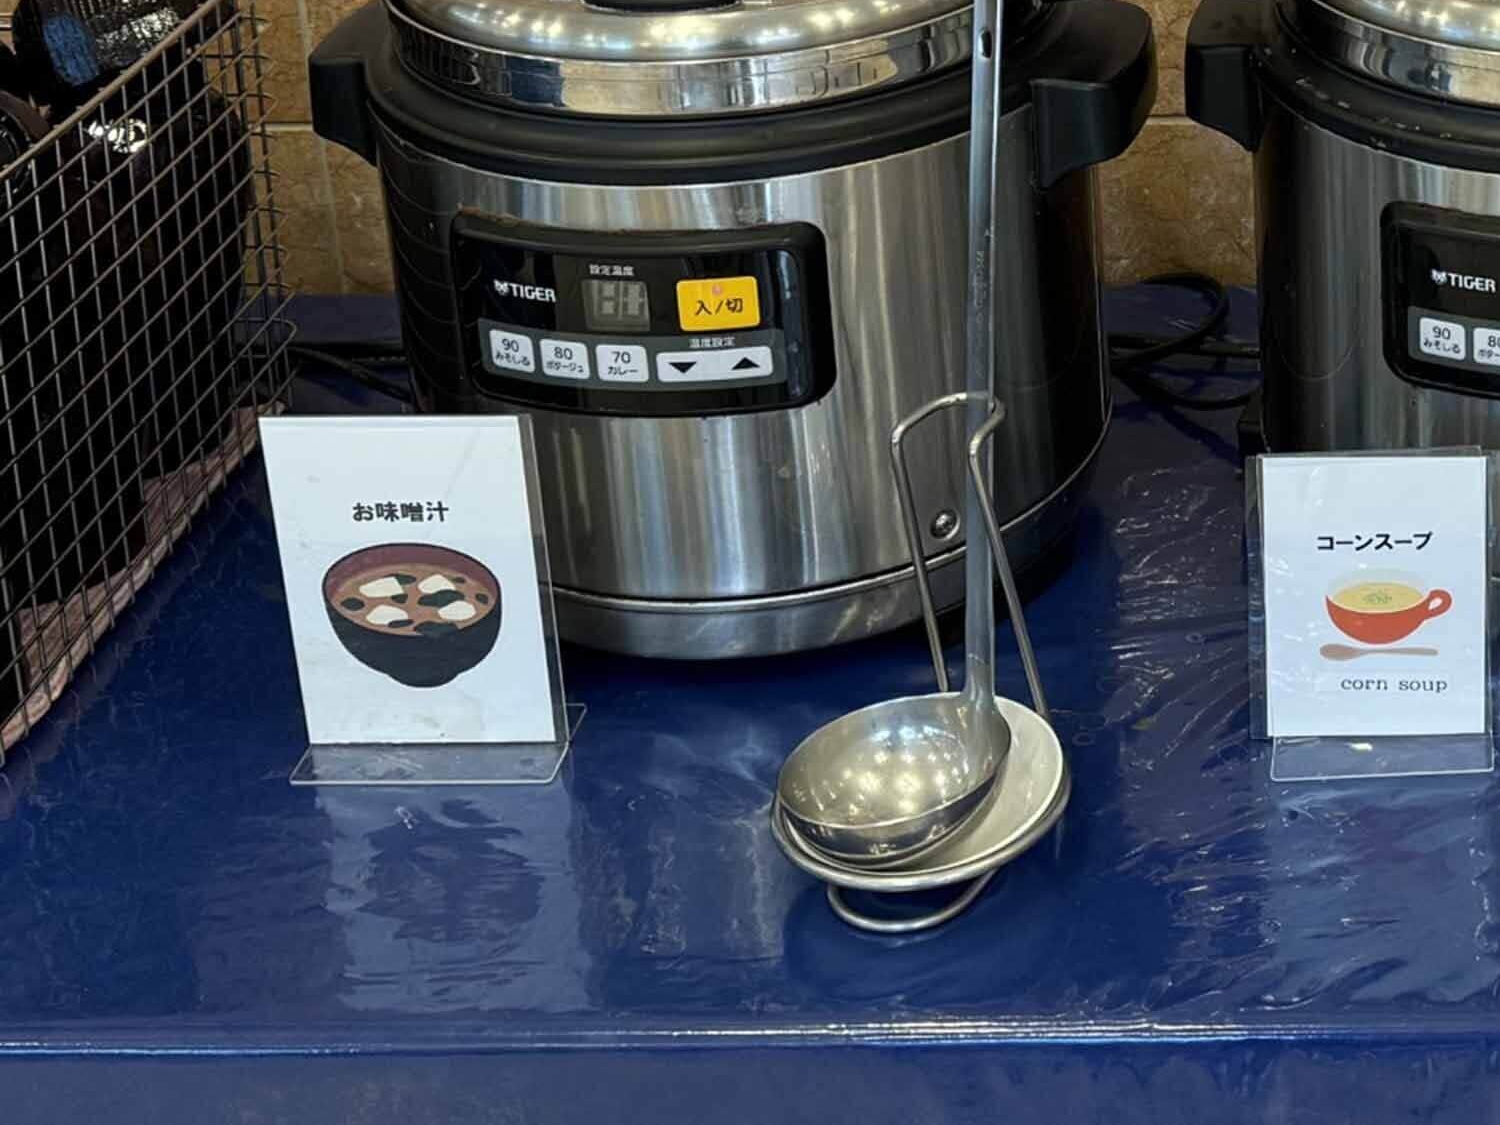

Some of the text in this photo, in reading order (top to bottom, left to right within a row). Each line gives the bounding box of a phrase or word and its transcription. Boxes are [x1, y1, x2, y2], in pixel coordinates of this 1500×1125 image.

[1448, 272, 1496, 293] TIGER
[511, 282, 556, 303] TIGER
[694, 297, 743, 316] 入/切
[1432, 326, 1451, 340] 90
[501, 338, 520, 353] 90
[553, 346, 574, 361] 80
[1423, 338, 1461, 354] みそしる
[494, 351, 531, 367] みそしる
[611, 351, 631, 365] 70
[607, 365, 638, 377] カレー
[352, 501, 450, 522] お味噌汁
[1317, 532, 1433, 551] コーンスープ
[1340, 678, 1448, 693] corn soup
